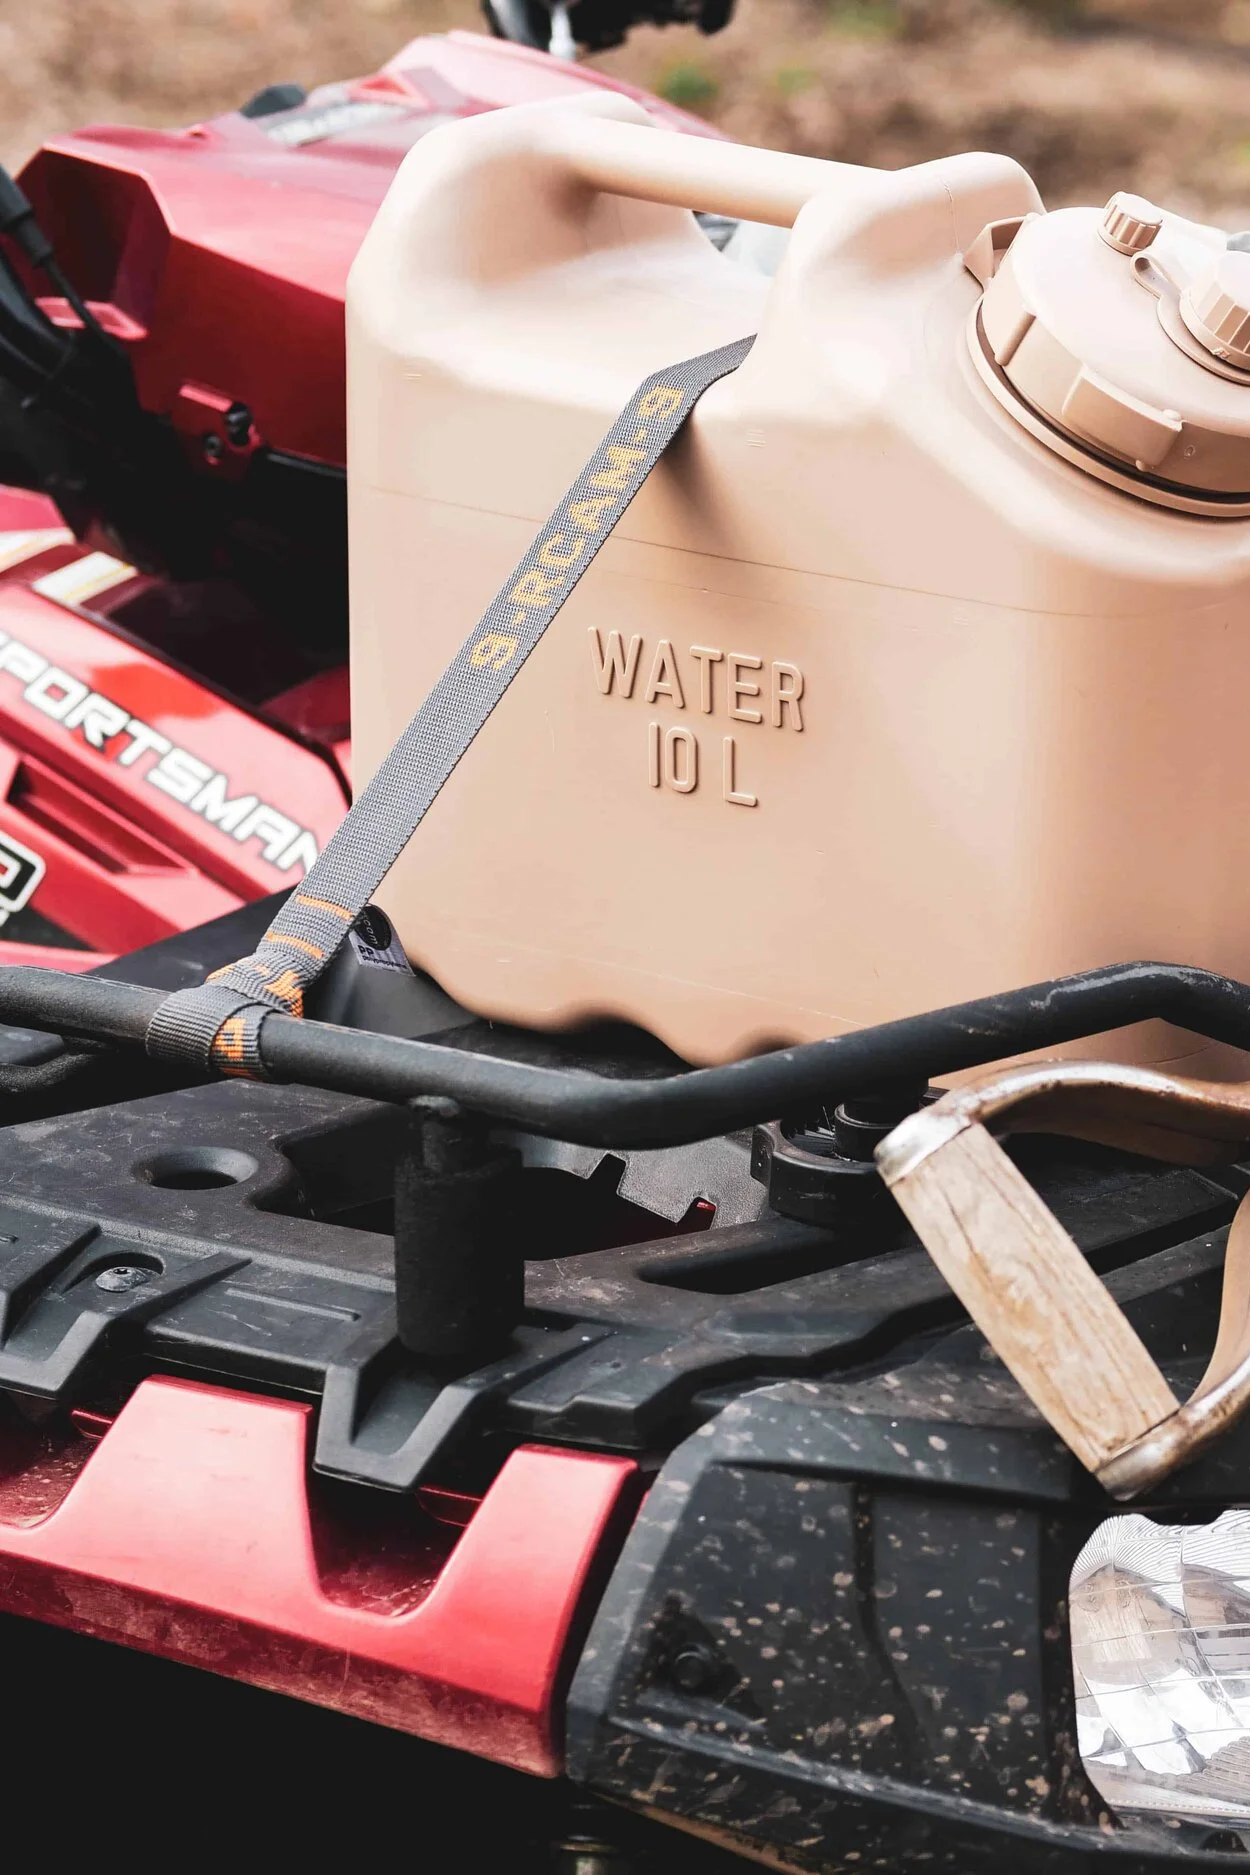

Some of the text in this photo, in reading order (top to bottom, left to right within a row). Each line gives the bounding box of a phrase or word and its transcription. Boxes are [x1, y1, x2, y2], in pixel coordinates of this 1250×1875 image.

[587, 626, 805, 732] WATER
[648, 721, 758, 807] 10 L
